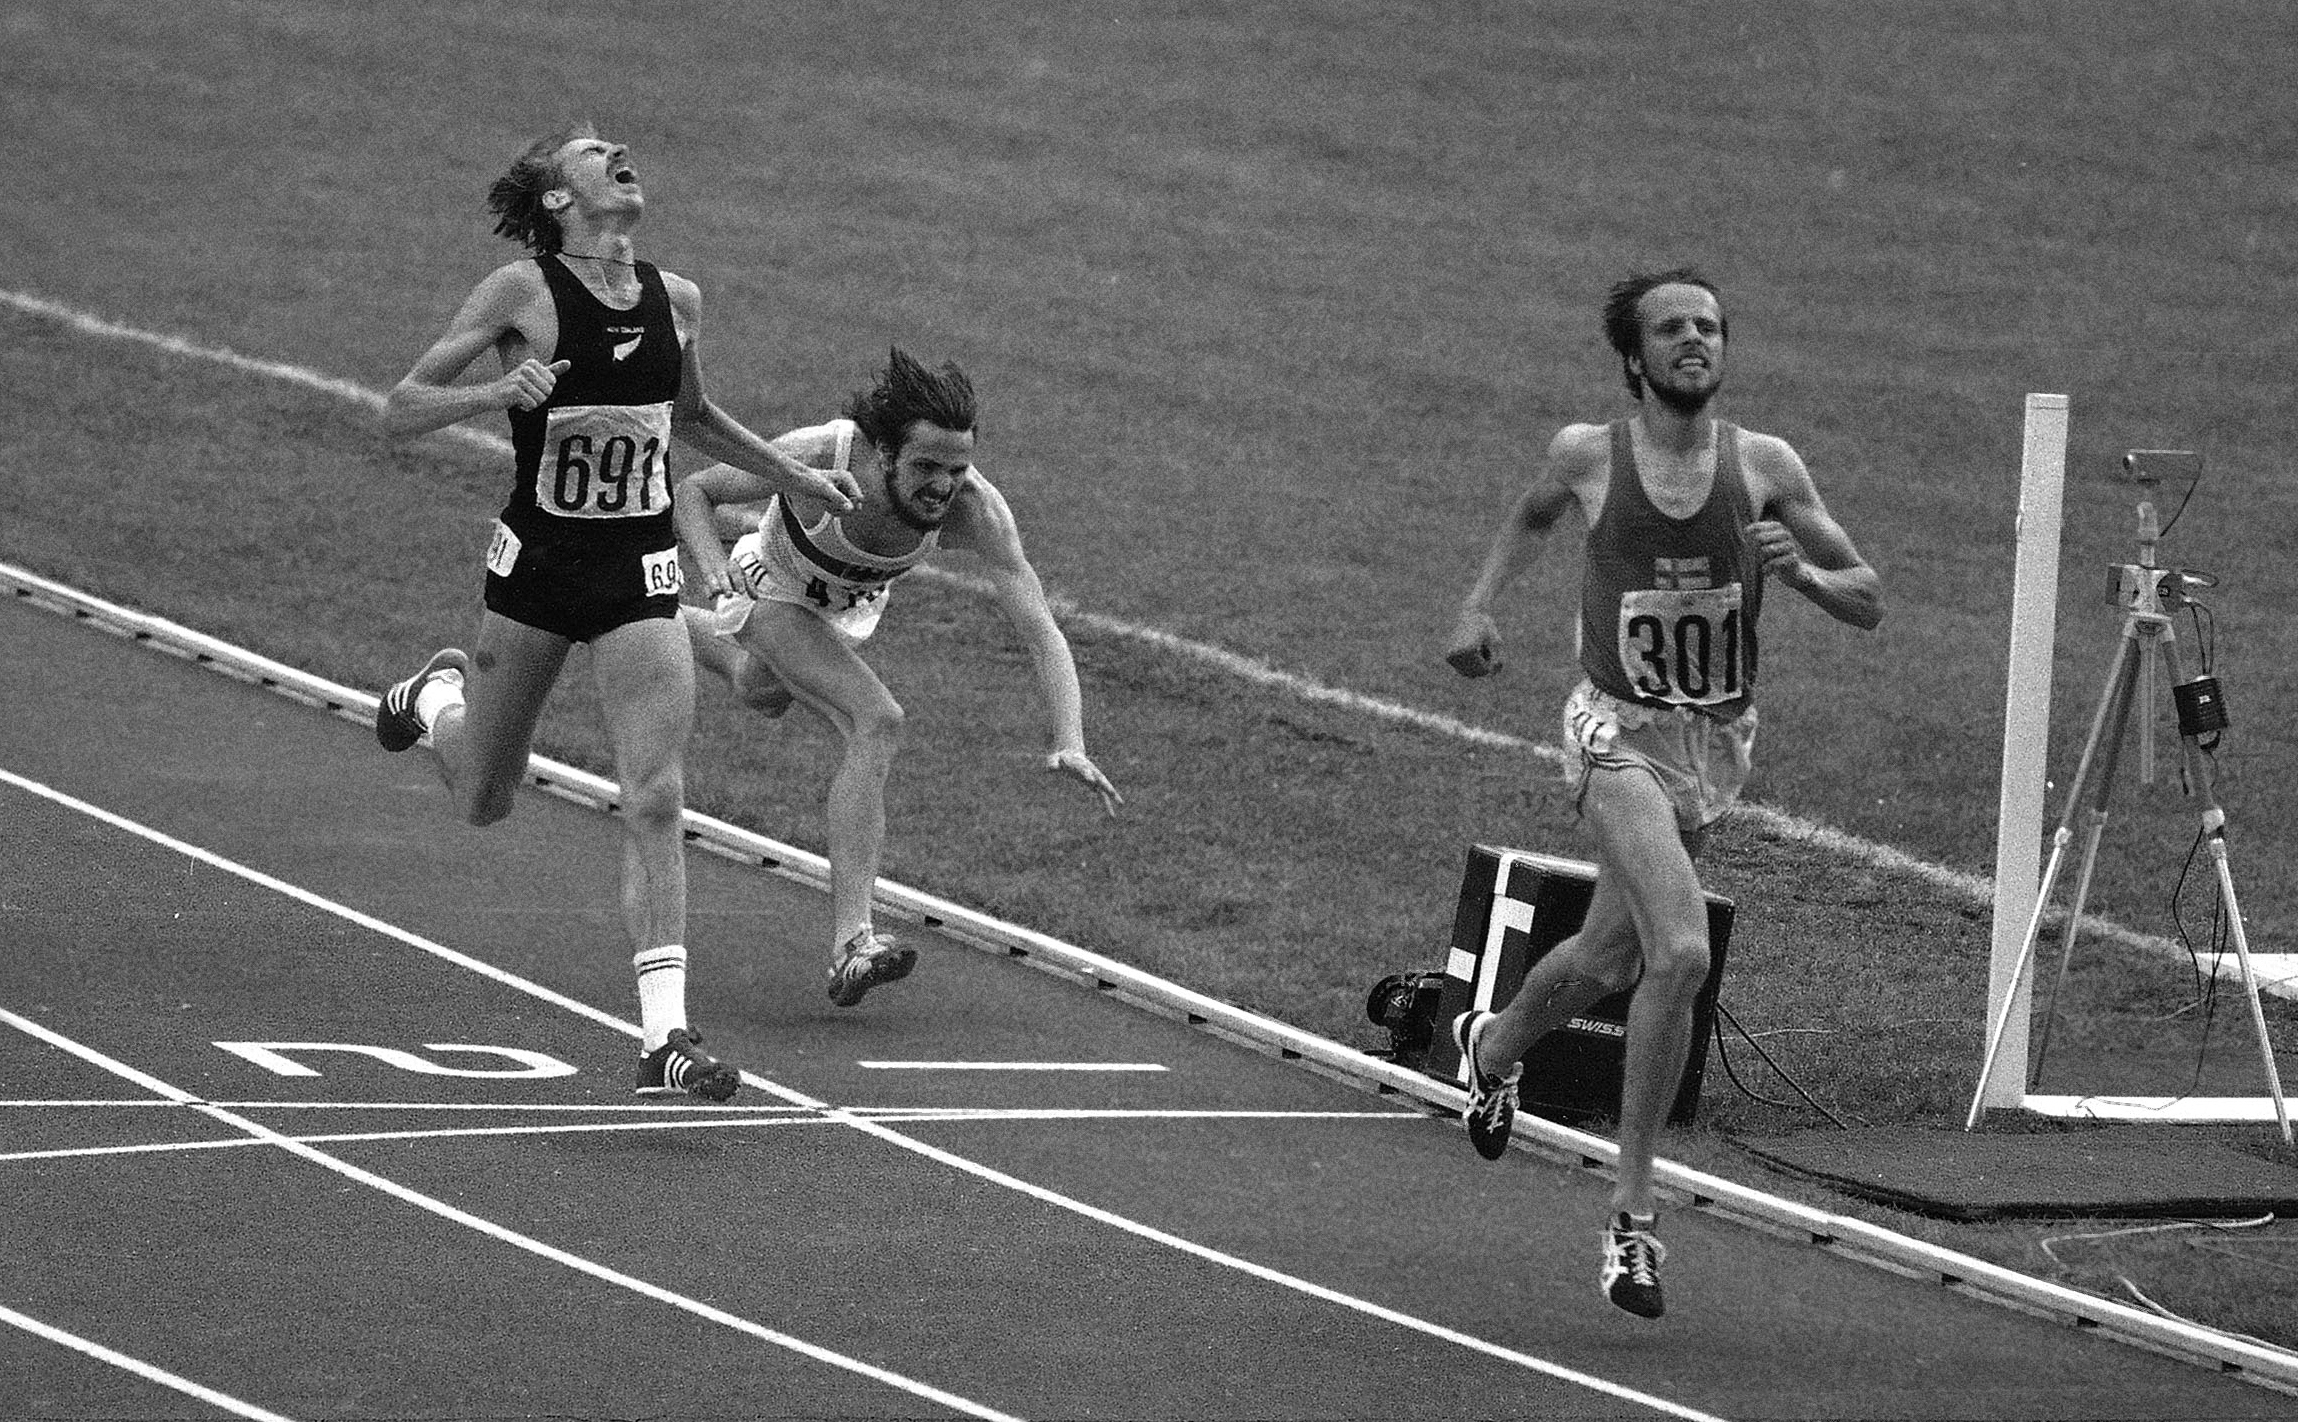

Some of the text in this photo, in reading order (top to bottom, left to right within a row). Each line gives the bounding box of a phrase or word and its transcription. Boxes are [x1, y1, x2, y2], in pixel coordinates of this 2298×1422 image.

[553, 434, 660, 513] 691
[652, 560, 681, 590] 69
[1628, 610, 1738, 699] 301
[1566, 1018, 1626, 1037] SWISS
[210, 1041, 579, 1079] 2
